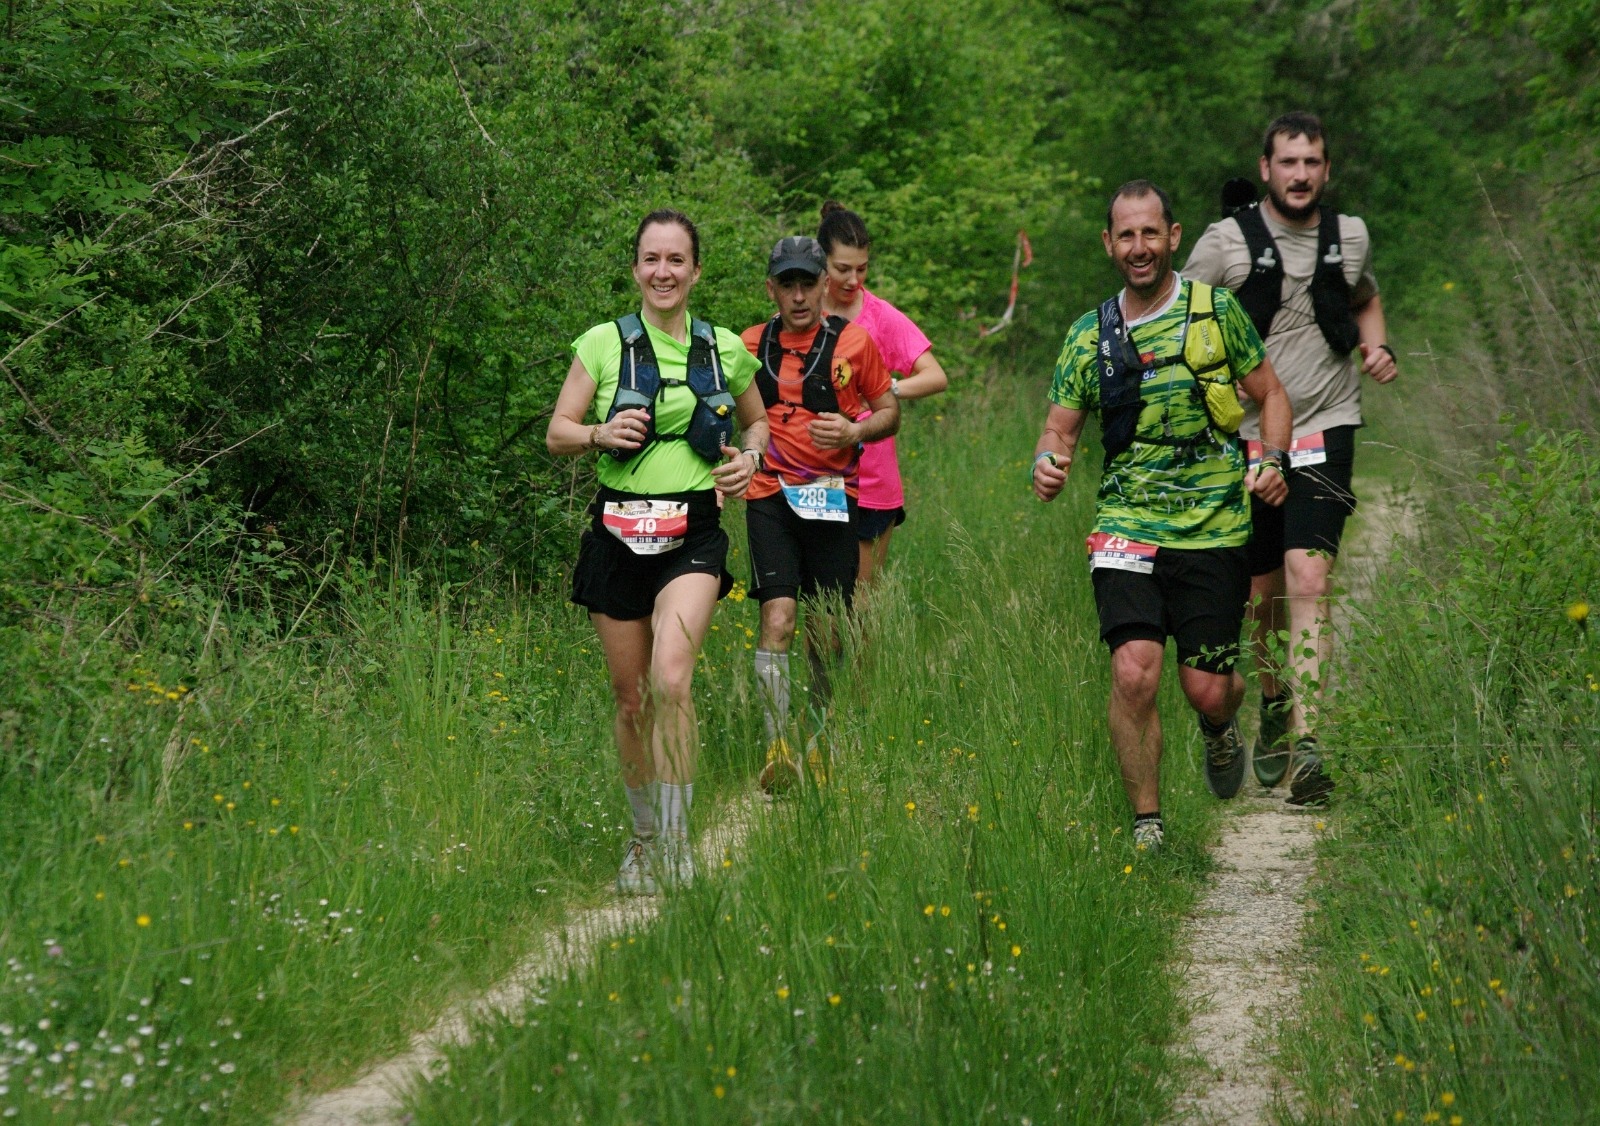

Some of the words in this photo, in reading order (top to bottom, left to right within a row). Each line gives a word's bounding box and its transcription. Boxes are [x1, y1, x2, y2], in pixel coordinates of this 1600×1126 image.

[798, 488, 827, 507] 289
[632, 518, 657, 534] 40
[1103, 536, 1129, 549] 25
